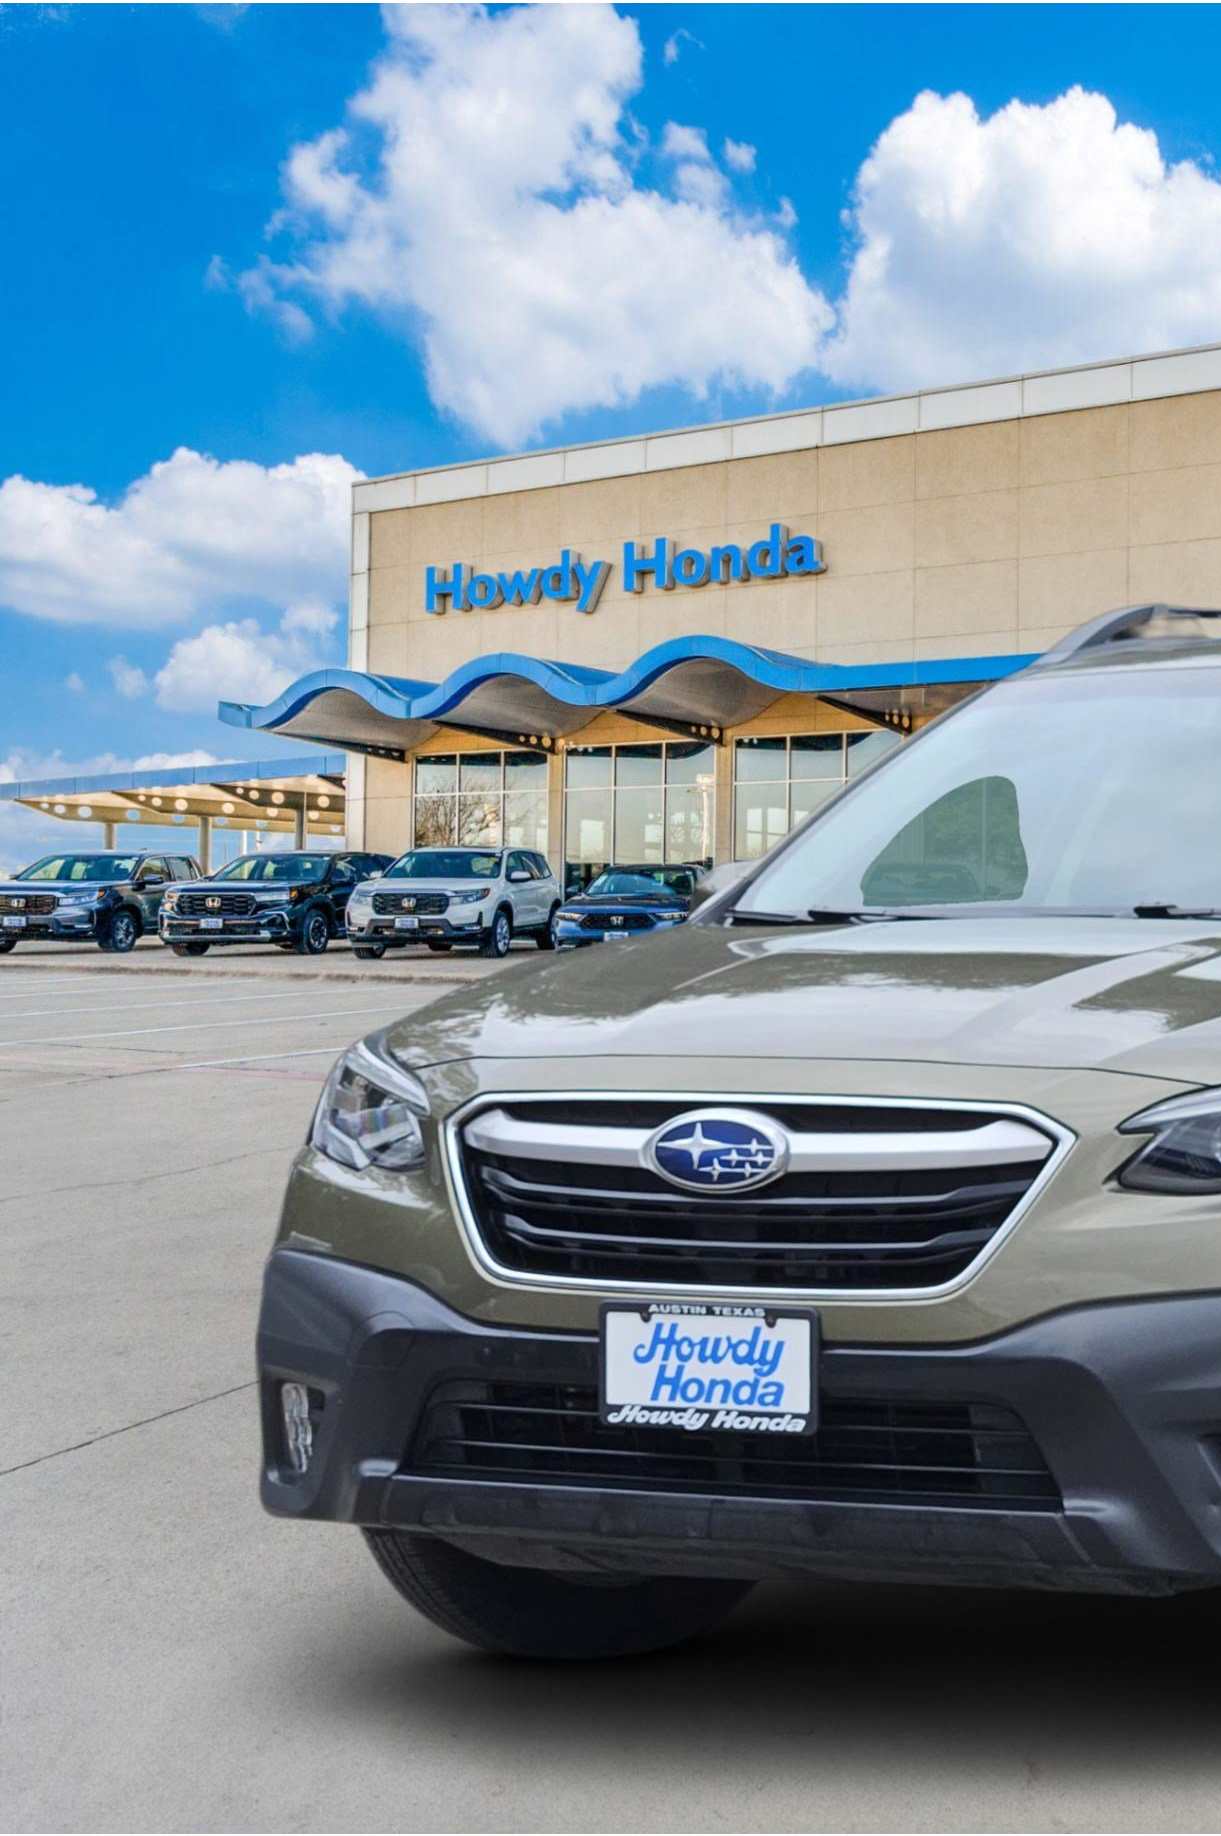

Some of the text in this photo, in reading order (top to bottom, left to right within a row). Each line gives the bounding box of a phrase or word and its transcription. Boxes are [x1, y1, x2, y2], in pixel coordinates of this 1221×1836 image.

[425, 522, 826, 614] Howdy Honda
[648, 1303, 766, 1317] AUSTIN TEXAS
[633, 1322, 785, 1377] Howdy
[650, 1364, 785, 1407] Honda
[607, 1405, 807, 1433] Howdy Honda
